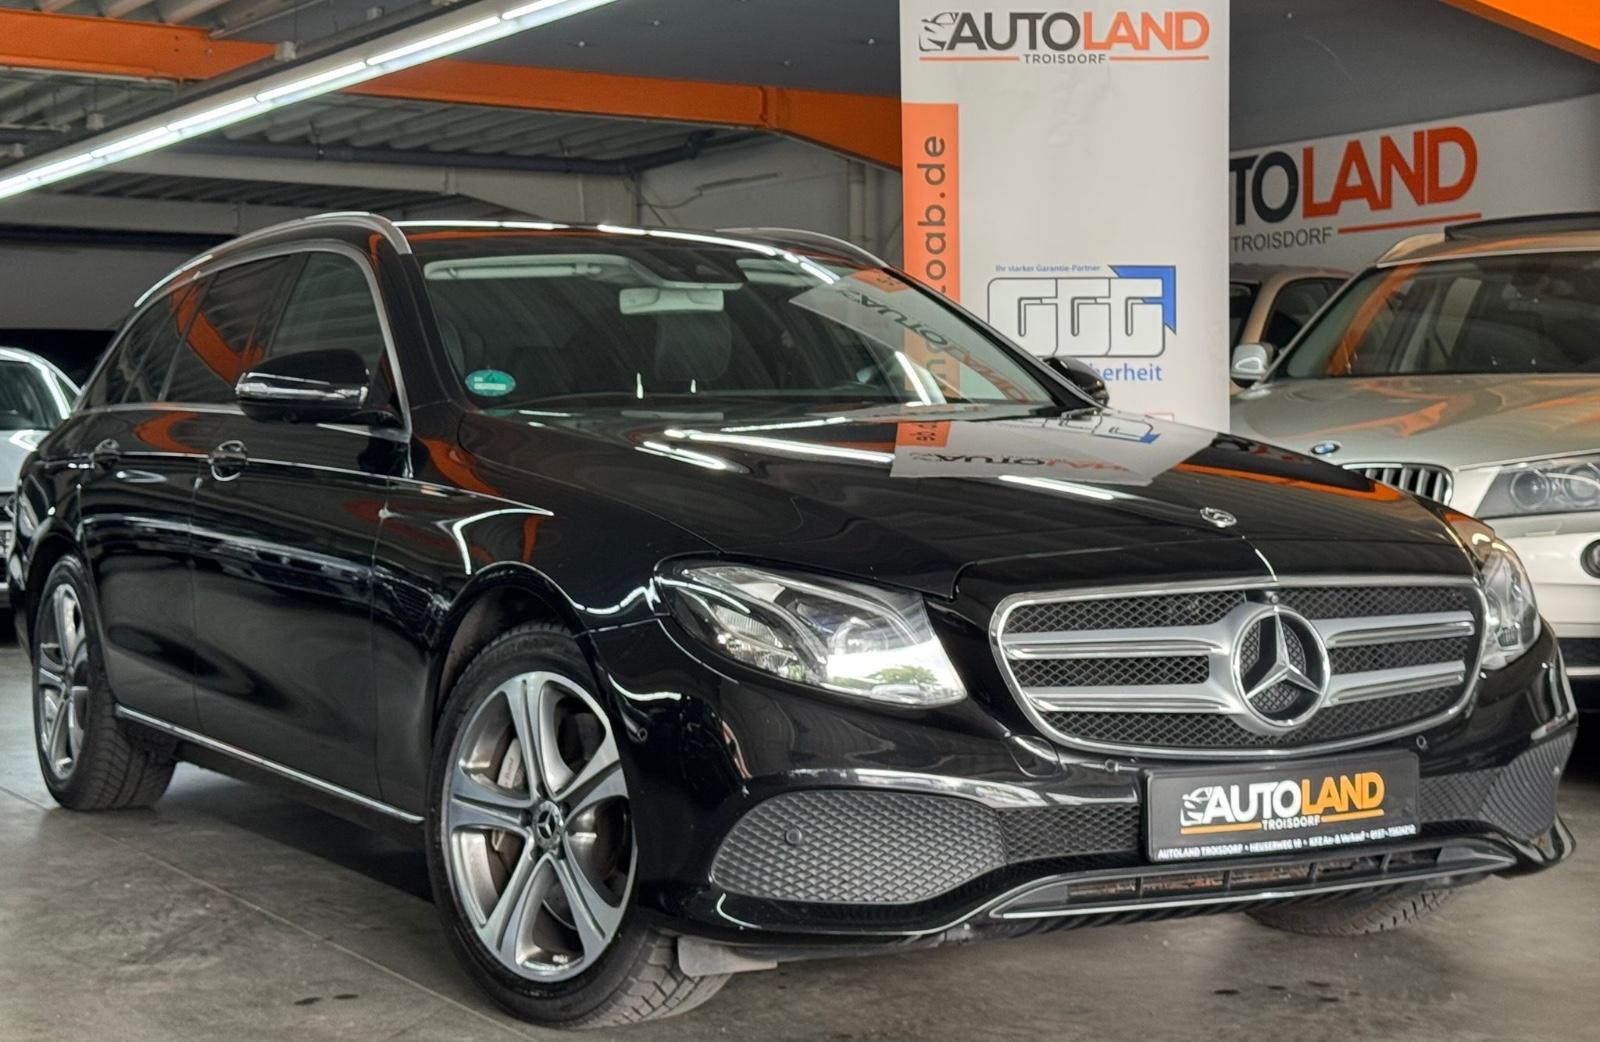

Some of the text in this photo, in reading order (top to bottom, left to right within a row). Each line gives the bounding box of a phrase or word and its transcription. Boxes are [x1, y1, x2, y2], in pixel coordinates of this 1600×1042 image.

[949, 11, 1210, 51] AUTOLAND
[1023, 53, 1107, 65] TROISDORF
[1231, 226, 1334, 253] TROISDORF
[1090, 362, 1162, 381] erheit
[1202, 772, 1385, 823] AUTOLAND
[1262, 814, 1321, 831] TROISDORF
[1157, 846, 1201, 860] AUTOLAND
